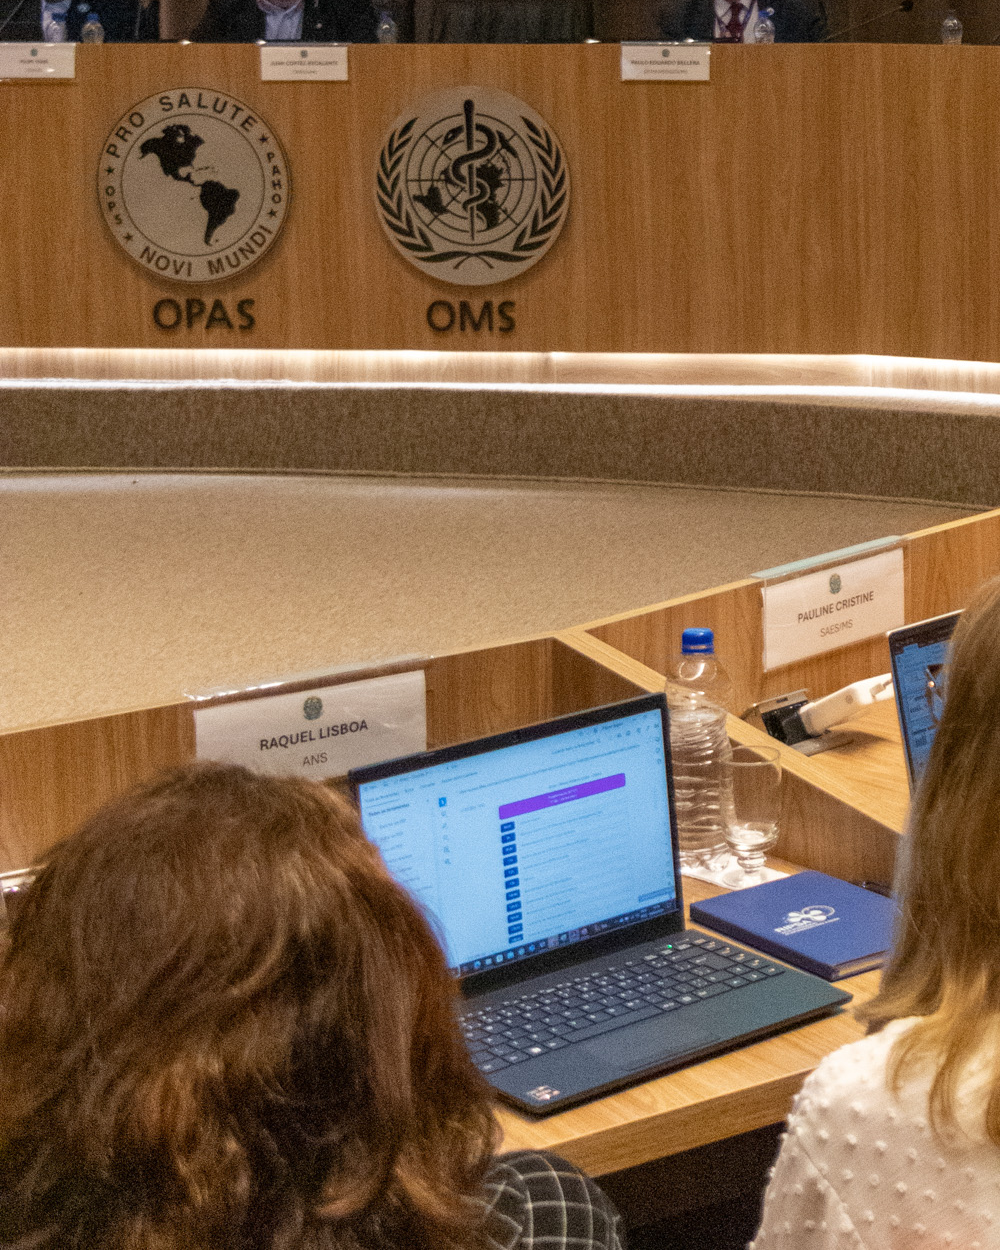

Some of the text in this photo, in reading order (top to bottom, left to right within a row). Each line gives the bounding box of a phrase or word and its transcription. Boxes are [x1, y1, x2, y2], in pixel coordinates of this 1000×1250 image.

[106, 92, 259, 159] PRO SALUTE
[266, 152, 282, 204] PAHO
[105, 185, 124, 226] OPS
[139, 224, 274, 277] NOVI MUNDI
[152, 298, 255, 331] OPAS
[426, 299, 517, 333] OMS
[797, 590, 875, 624] PAULINE CRISTINE
[820, 619, 854, 638] SAES/MS
[259, 719, 369, 751] RAQUEL LISBOA
[302, 752, 328, 768] ANS
